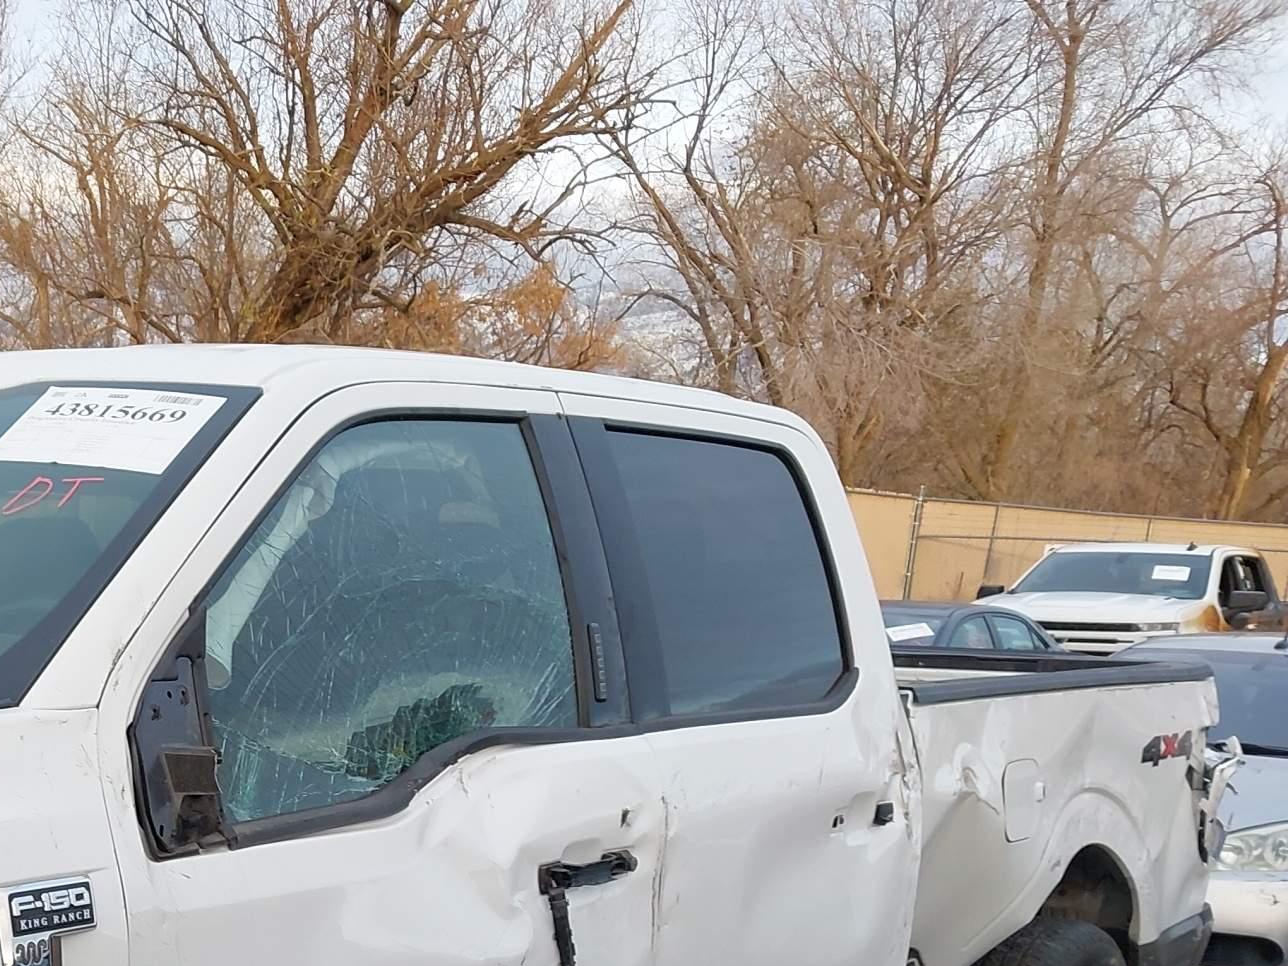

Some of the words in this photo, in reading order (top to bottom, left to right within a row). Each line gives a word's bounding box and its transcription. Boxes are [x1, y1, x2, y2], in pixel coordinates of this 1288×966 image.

[43, 402, 187, 424] 43815669
[1, 476, 105, 515] DT
[11, 886, 91, 917] F-150
[19, 917, 48, 931] KING
[53, 909, 92, 925] RANCH
